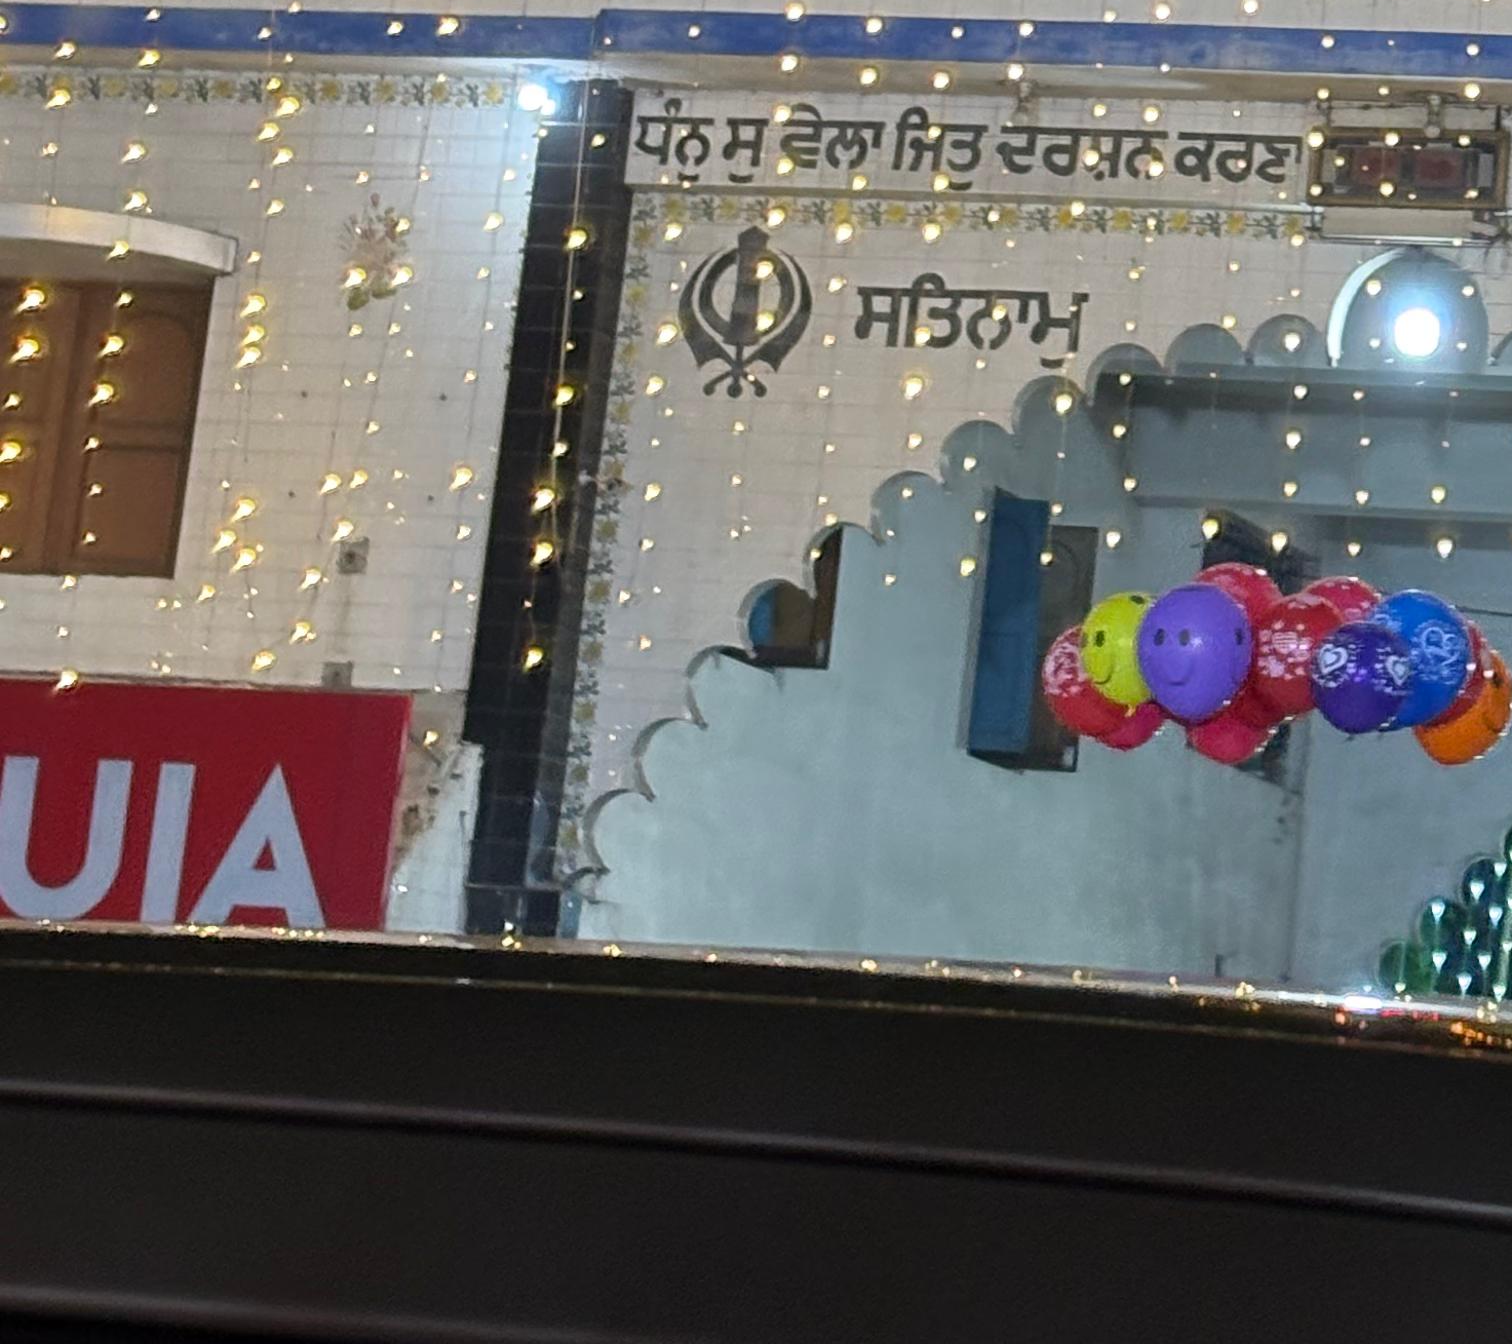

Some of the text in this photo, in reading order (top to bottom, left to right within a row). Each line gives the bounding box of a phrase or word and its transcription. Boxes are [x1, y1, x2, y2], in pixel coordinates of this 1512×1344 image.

[635, 98, 715, 182] ਧੰਨੁ
[723, 118, 769, 183] ਸੁ
[780, 103, 886, 169] ਵੇਲਾ
[891, 107, 988, 190] ਜਿਤੁ
[1174, 132, 1303, 183] ਕਰਣਾ
[854, 273, 1090, 369] ਸਤਿਨਾਮੁ
